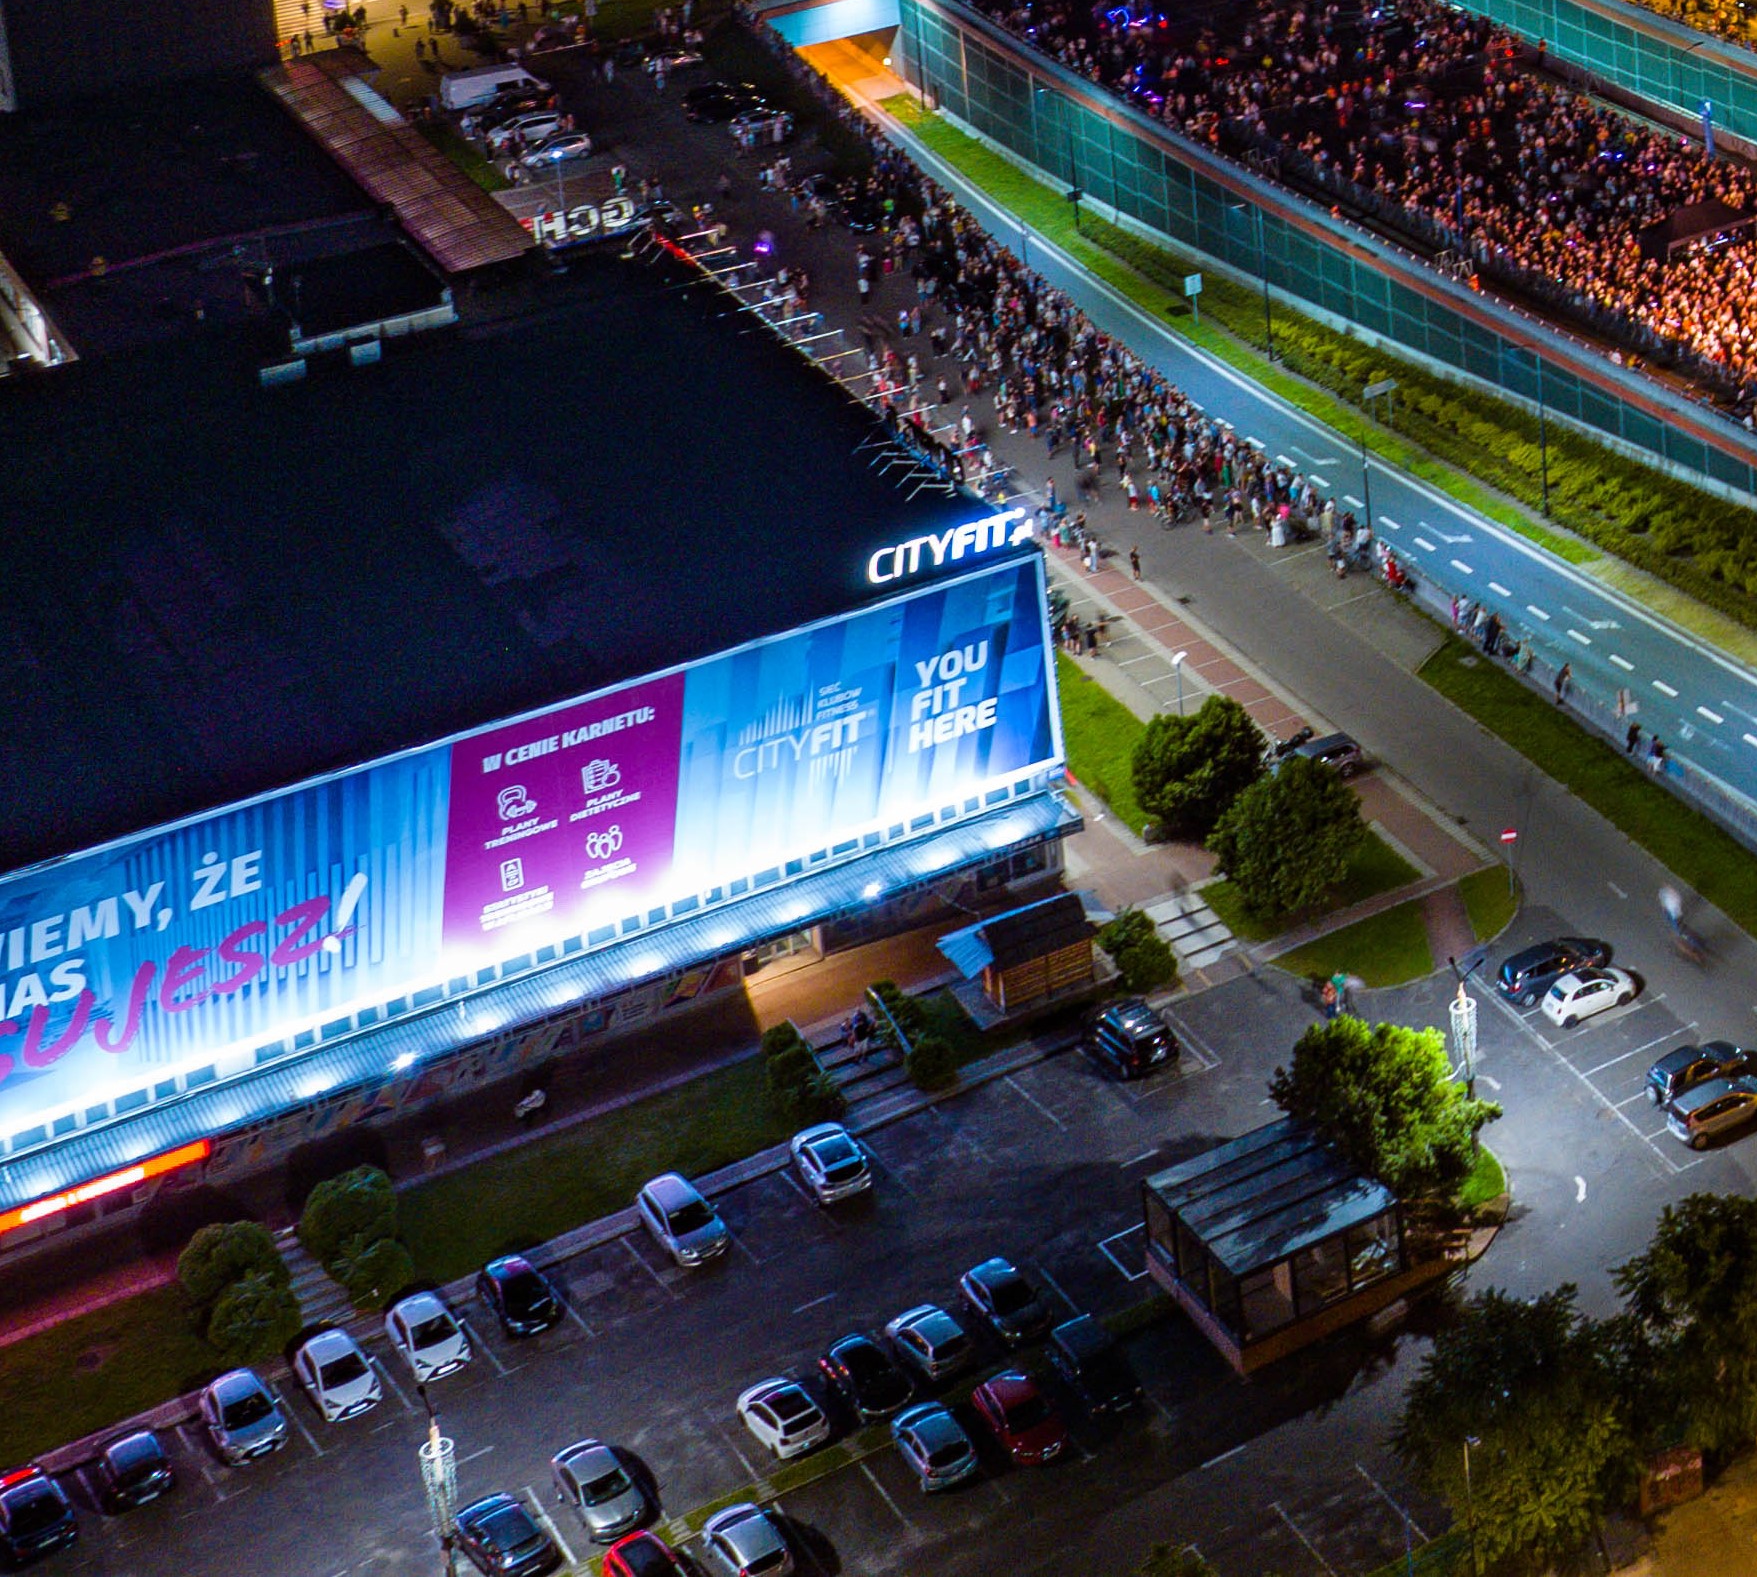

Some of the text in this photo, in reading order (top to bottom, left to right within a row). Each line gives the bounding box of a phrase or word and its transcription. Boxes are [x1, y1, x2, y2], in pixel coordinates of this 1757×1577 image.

[868, 509, 1020, 584] CITYFIT
[914, 640, 989, 689] YOU
[815, 699, 859, 721] FITNESS
[911, 677, 968, 722] FIT
[482, 706, 655, 774] W CENIE KARNETU:
[734, 711, 867, 780] CITYFIT
[908, 696, 998, 754] HERE
[569, 792, 642, 822] DIETETYCZNE
[586, 789, 623, 808] PLANY
[501, 817, 540, 836] PLANY
[0, 850, 262, 971] IEMY, ŻE
